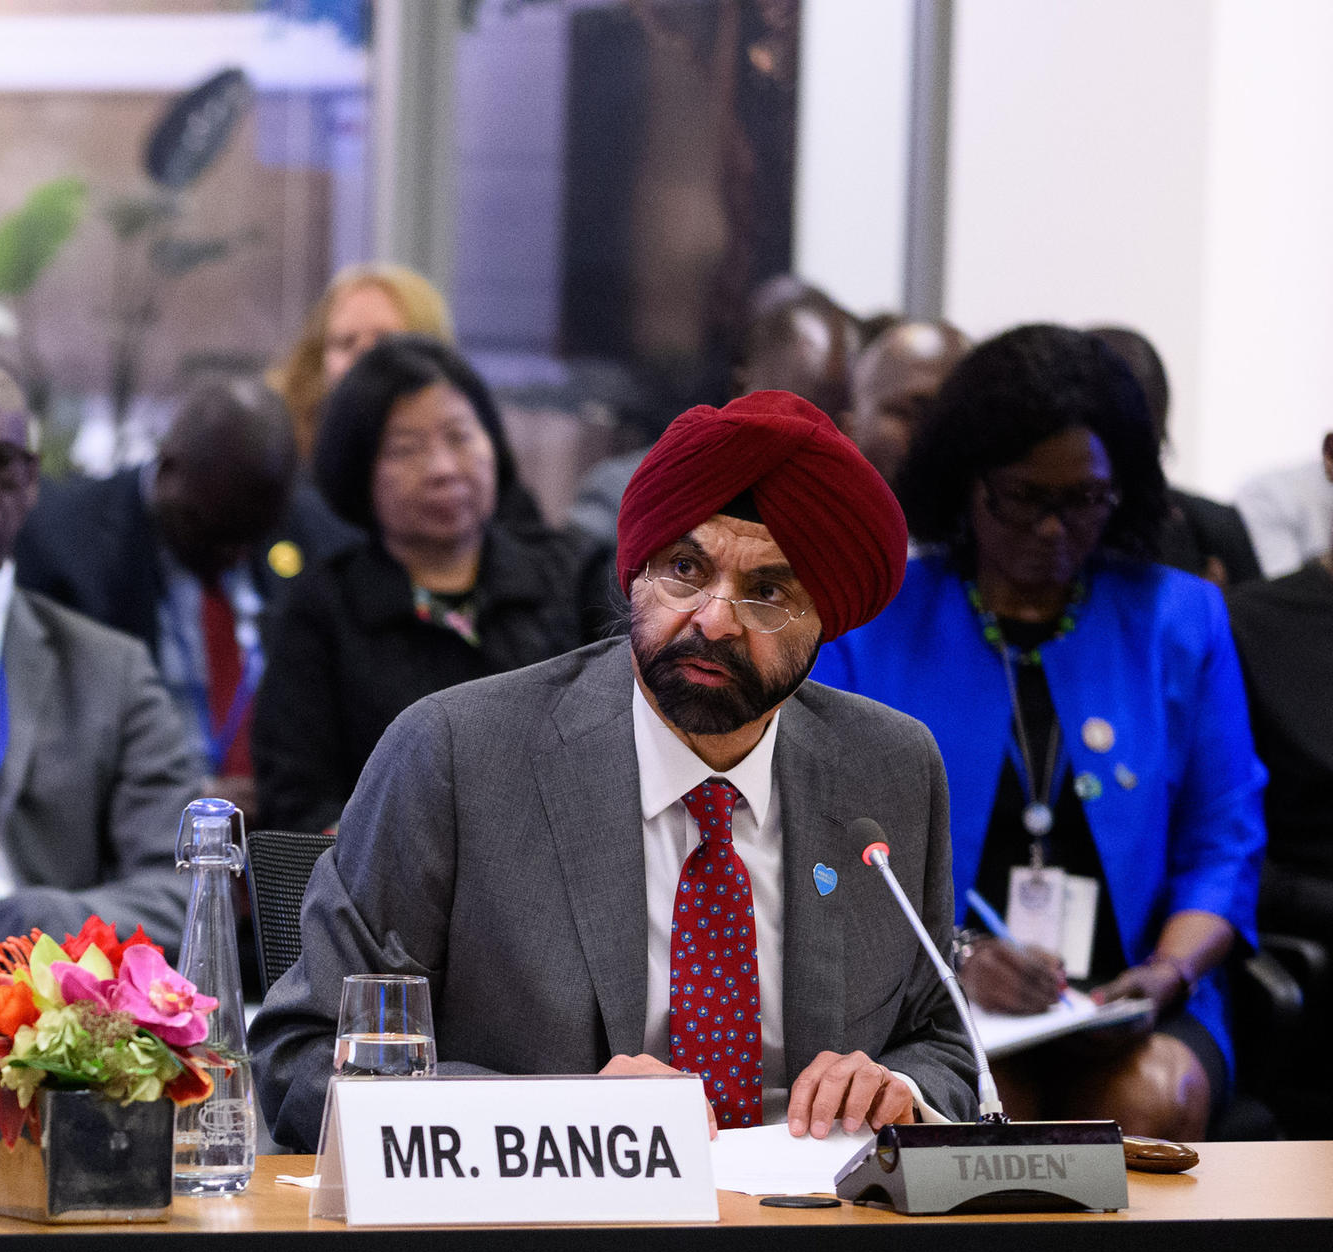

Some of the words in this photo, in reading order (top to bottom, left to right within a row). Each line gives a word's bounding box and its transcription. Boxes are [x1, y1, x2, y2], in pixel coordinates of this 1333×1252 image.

[380, 1125, 479, 1179] MR.
[494, 1125, 682, 1179] BANGA
[951, 1154, 1069, 1181] TAIDEN
